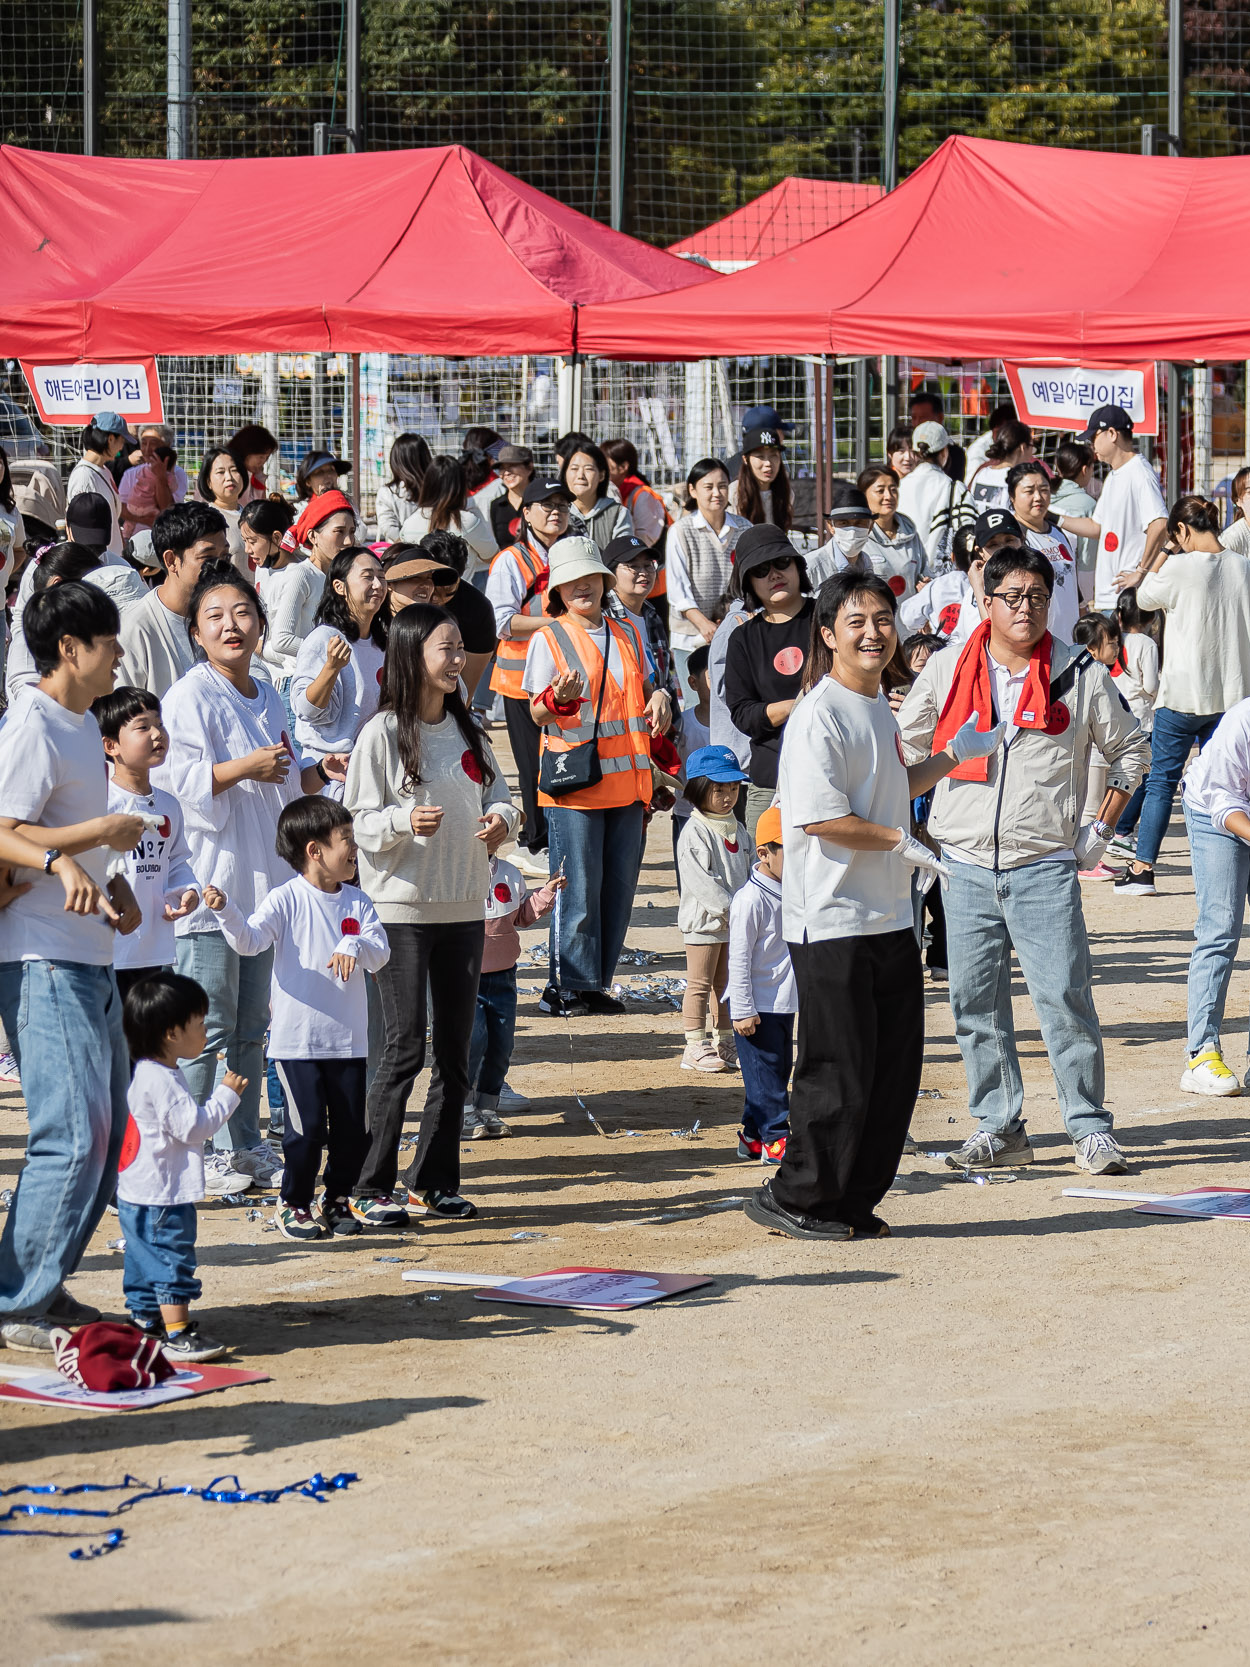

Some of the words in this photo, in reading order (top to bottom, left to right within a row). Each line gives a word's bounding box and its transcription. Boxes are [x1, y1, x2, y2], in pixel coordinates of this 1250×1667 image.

[44, 377, 140, 403] 해든어린이집
[1032, 381, 1134, 409] 예일어린이집
[987, 513, 1004, 529] B
